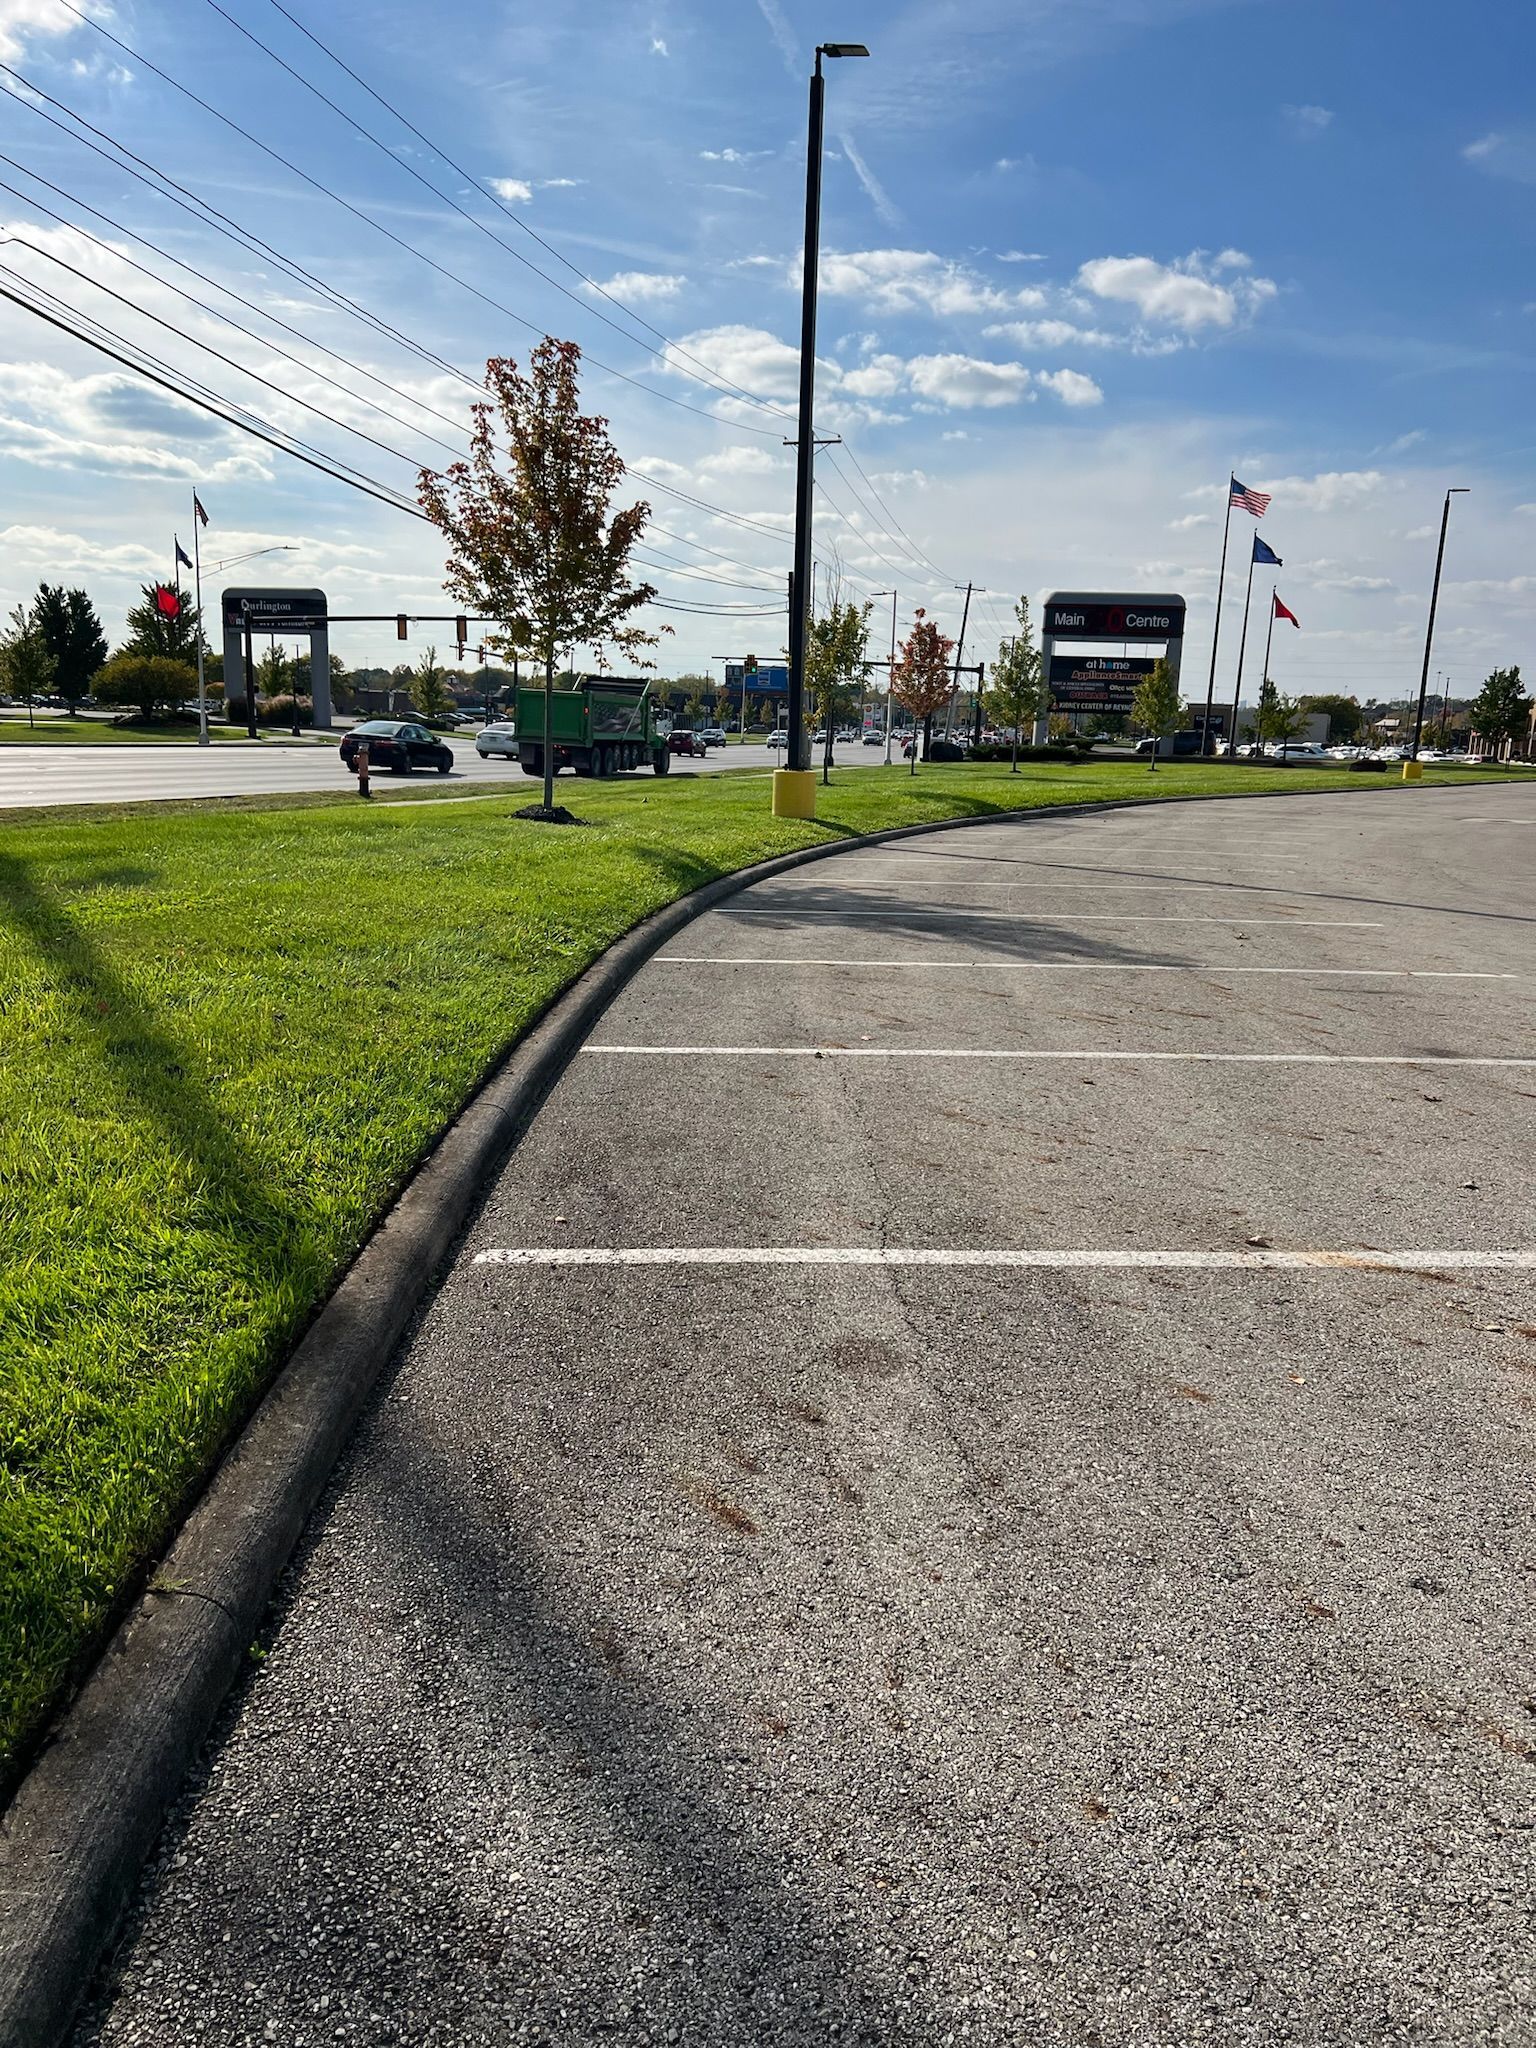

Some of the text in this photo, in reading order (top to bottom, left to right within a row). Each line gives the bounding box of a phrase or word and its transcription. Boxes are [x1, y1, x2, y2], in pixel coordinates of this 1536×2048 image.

[1054, 612, 1085, 626] Main
[1126, 613, 1170, 628] Centre
[1086, 660, 1098, 669] at
[1080, 702, 1103, 710] CENTER
[1104, 703, 1112, 711] OF
